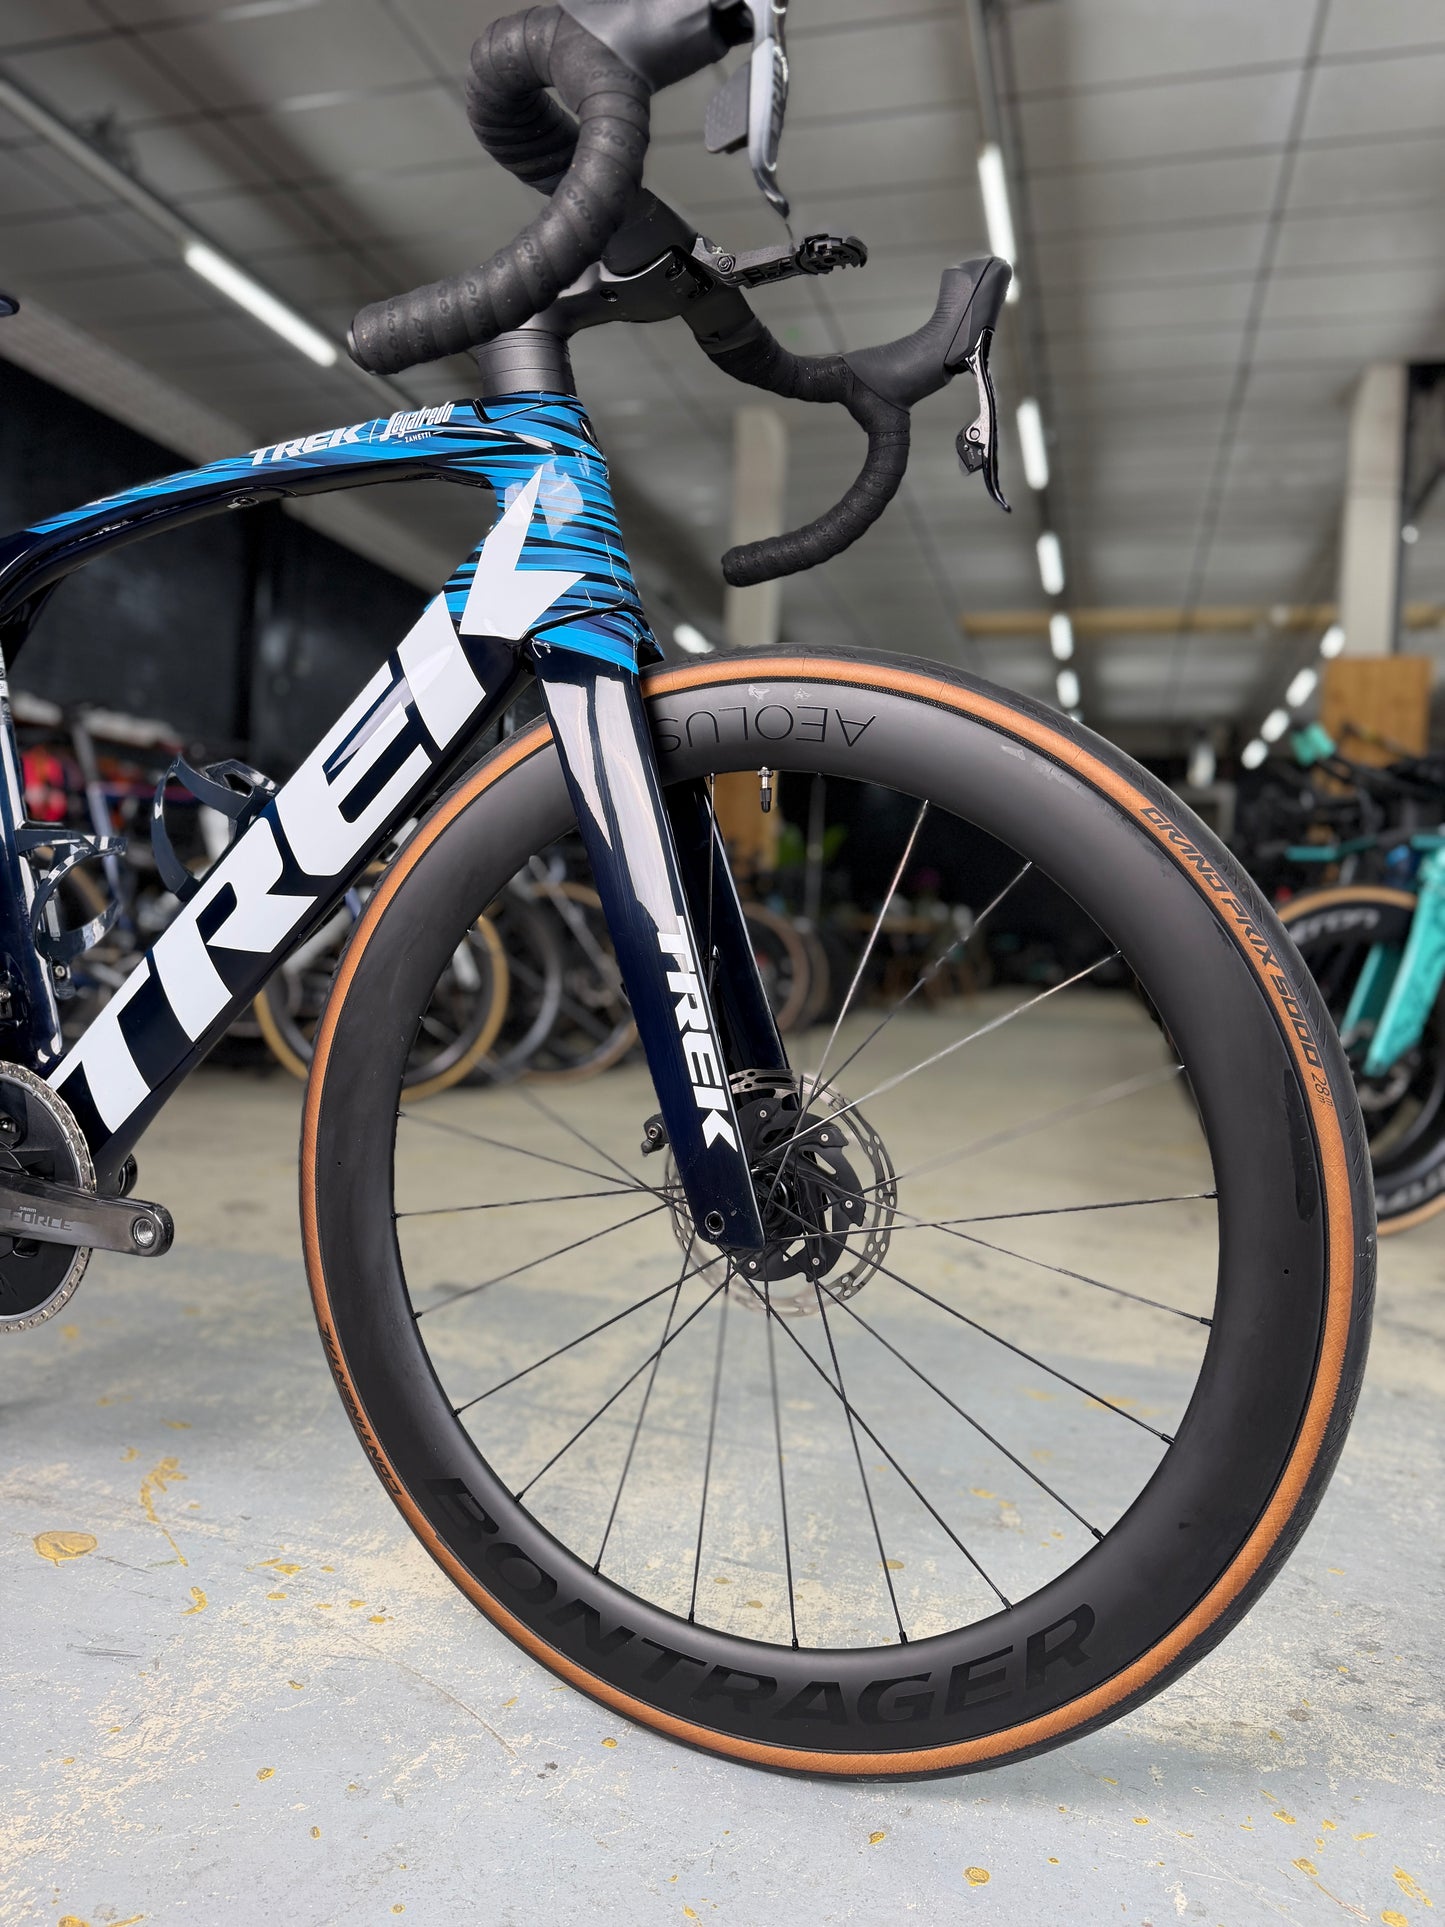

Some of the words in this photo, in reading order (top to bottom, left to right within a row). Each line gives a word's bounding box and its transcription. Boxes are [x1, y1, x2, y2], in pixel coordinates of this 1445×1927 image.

[249, 422, 368, 466] TREK
[379, 401, 455, 442] Segafredo
[404, 431, 432, 443] ZANETTI
[47, 464, 585, 1134] TREK
[653, 704, 876, 752] AEOLUS
[1140, 806, 1230, 892] GRAND
[1221, 898, 1280, 967] PRIX
[1269, 974, 1323, 1069] 5000
[656, 915, 738, 1152] TREK
[10, 1210, 73, 1232] FORCE
[423, 1476, 1097, 1726] BONTRAGER
